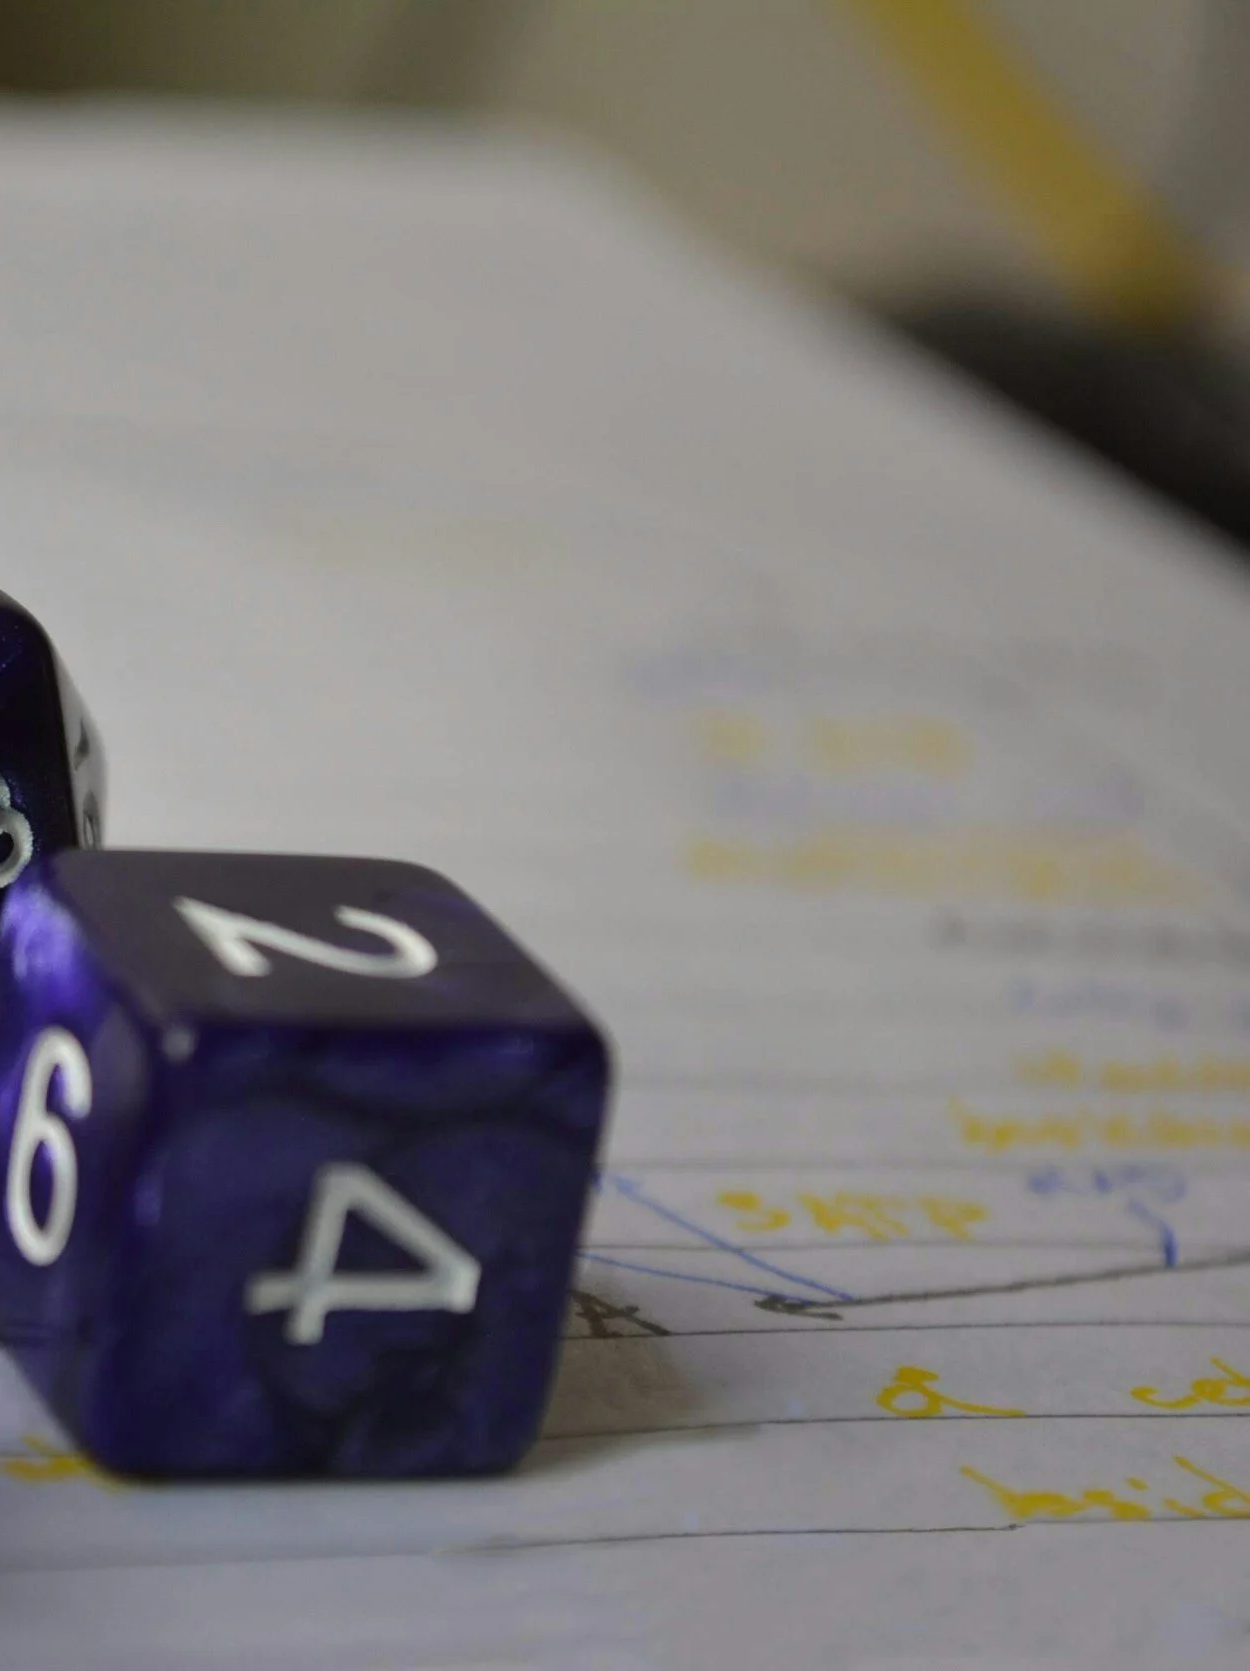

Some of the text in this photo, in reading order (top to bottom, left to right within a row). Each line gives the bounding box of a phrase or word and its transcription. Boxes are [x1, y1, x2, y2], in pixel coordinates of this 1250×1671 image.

[173, 896, 438, 977] 2
[5, 1025, 92, 1267] 6
[244, 1162, 482, 1346] 4
